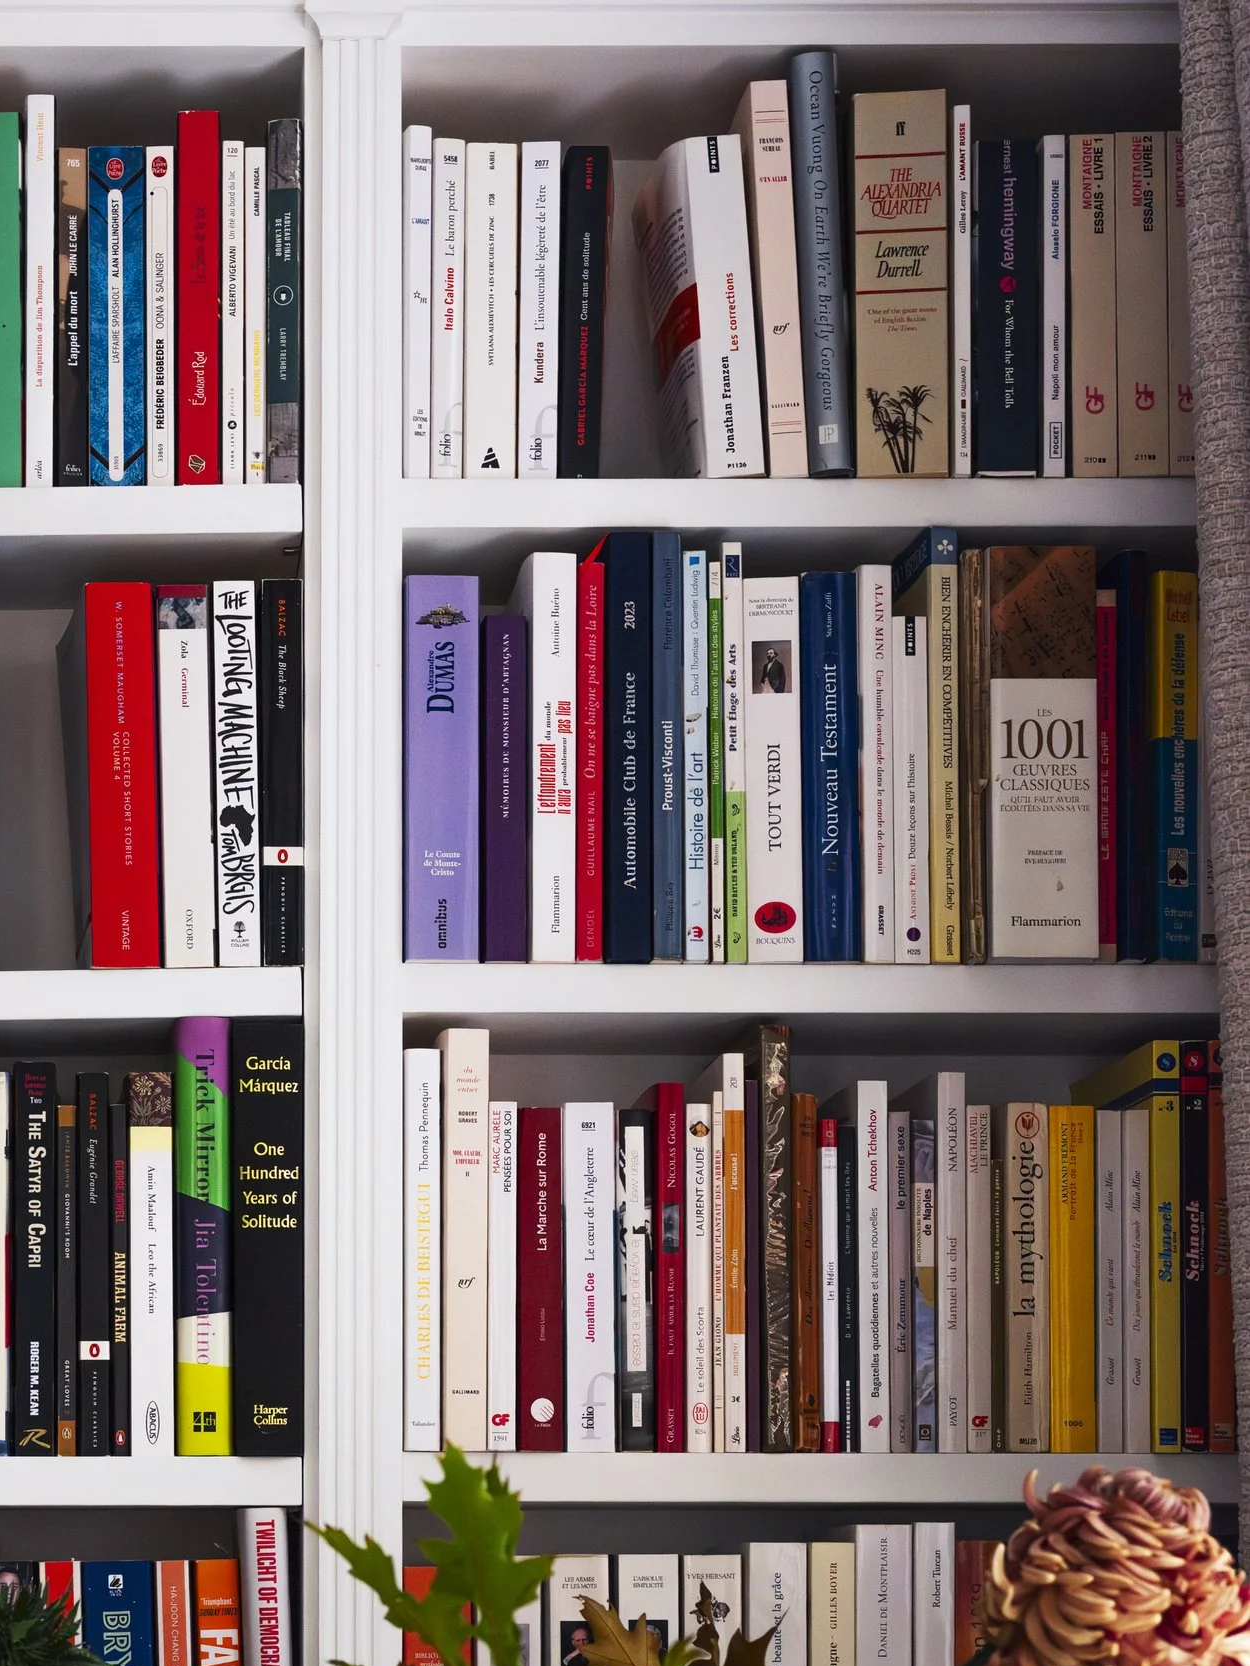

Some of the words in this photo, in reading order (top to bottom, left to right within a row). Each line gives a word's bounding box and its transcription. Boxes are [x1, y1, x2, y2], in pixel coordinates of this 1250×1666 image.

[1082, 138, 1093, 209] MONTAIGNE
[445, 181, 458, 211] perché
[68, 215, 77, 241] CARRÉ
[445, 215, 454, 241] baron
[68, 254, 77, 276] JOHN
[69, 243, 77, 252] LE
[445, 245, 454, 256] Le
[875, 241, 929, 258] Lawrence
[156, 253, 164, 292] SALINGER
[444, 268, 454, 304] Calvino
[876, 259, 922, 278] Durrell
[156, 305, 164, 329] OONA
[444, 308, 453, 330] Italo
[726, 273, 737, 330] corrections
[730, 335, 739, 351] Les
[156, 339, 164, 385] BEIGBEDER
[722, 356, 731, 399] Franzen
[154, 389, 164, 429] FRÉDÉRIC
[724, 403, 735, 453] Jonathan
[624, 601, 635, 629] 2023
[214, 615, 256, 697] LOOTING
[276, 686, 287, 709] Sheep
[623, 673, 635, 724] France
[820, 664, 837, 762] Testament
[216, 702, 255, 803] MACHINE
[624, 730, 635, 749] de
[1001, 719, 1089, 759] 1001
[623, 756, 636, 791] Club
[662, 721, 673, 810] Proust-Visconti
[767, 744, 781, 797] VERDI
[907, 754, 915, 788] l'histoire
[768, 802, 781, 851] TOUT
[822, 769, 838, 855] Nouveau
[907, 806, 916, 831] leçons
[624, 798, 636, 889] Automobile
[908, 834, 916, 859] Douze
[551, 876, 559, 933] Flammarion
[122, 910, 130, 950] VINTAGE
[435, 899, 447, 948] omnibus
[246, 1056, 290, 1070] García
[240, 1079, 298, 1094] Márquez
[419, 1083, 432, 1132] Pennequin
[254, 1142, 284, 1155] One
[537, 1133, 546, 1166] Rome
[868, 1109, 877, 1158] Tchekhov
[948, 1108, 957, 1172] NAPOLÉON
[419, 1136, 428, 1171] Thomas
[240, 1166, 299, 1179] Hundred
[868, 1160, 877, 1191] Anton
[148, 1194, 156, 1232] Maalouf
[243, 1191, 277, 1204] Years
[283, 1191, 297, 1204] of
[537, 1190, 547, 1234] Marche
[1011, 1140, 1043, 1285] mythologie
[242, 1215, 297, 1228] Solitude
[537, 1238, 547, 1250] La
[115, 1252, 126, 1303] ANIMAL
[1013, 1296, 1037, 1317] la
[115, 1307, 126, 1342] FARM
[933, 1550, 941, 1578] Turcan
[932, 1580, 940, 1607] Robert
